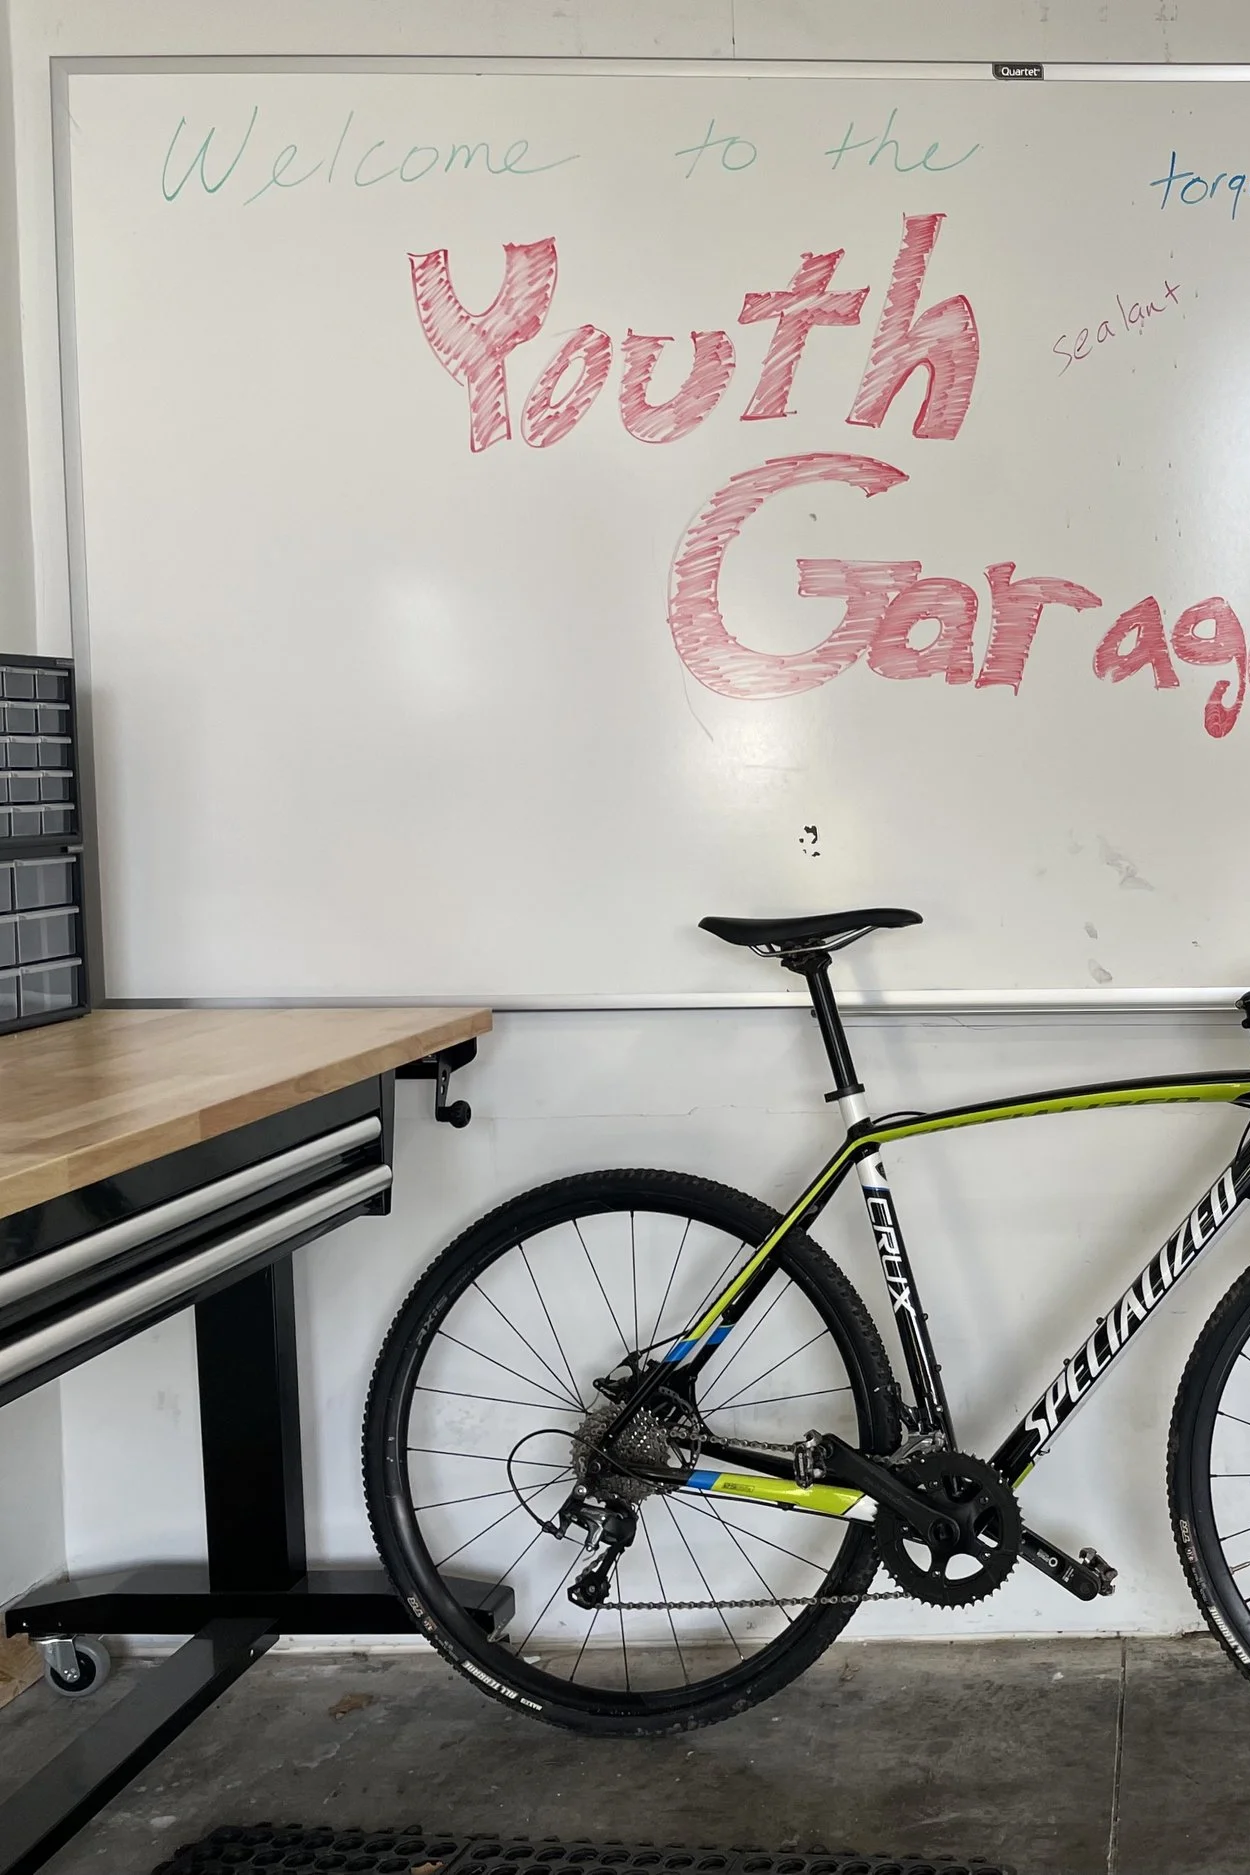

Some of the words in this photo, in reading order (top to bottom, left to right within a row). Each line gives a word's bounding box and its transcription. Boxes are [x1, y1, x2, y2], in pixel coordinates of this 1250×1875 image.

[1001, 66, 1040, 77] Quartet
[162, 105, 579, 206] Welcome
[676, 118, 757, 172] to
[824, 107, 983, 173] the
[406, 211, 981, 452] Youth
[1053, 280, 1181, 377] sealant
[866, 1197, 917, 1317] CRUX
[1025, 1166, 1238, 1458] SPECIALIZED
